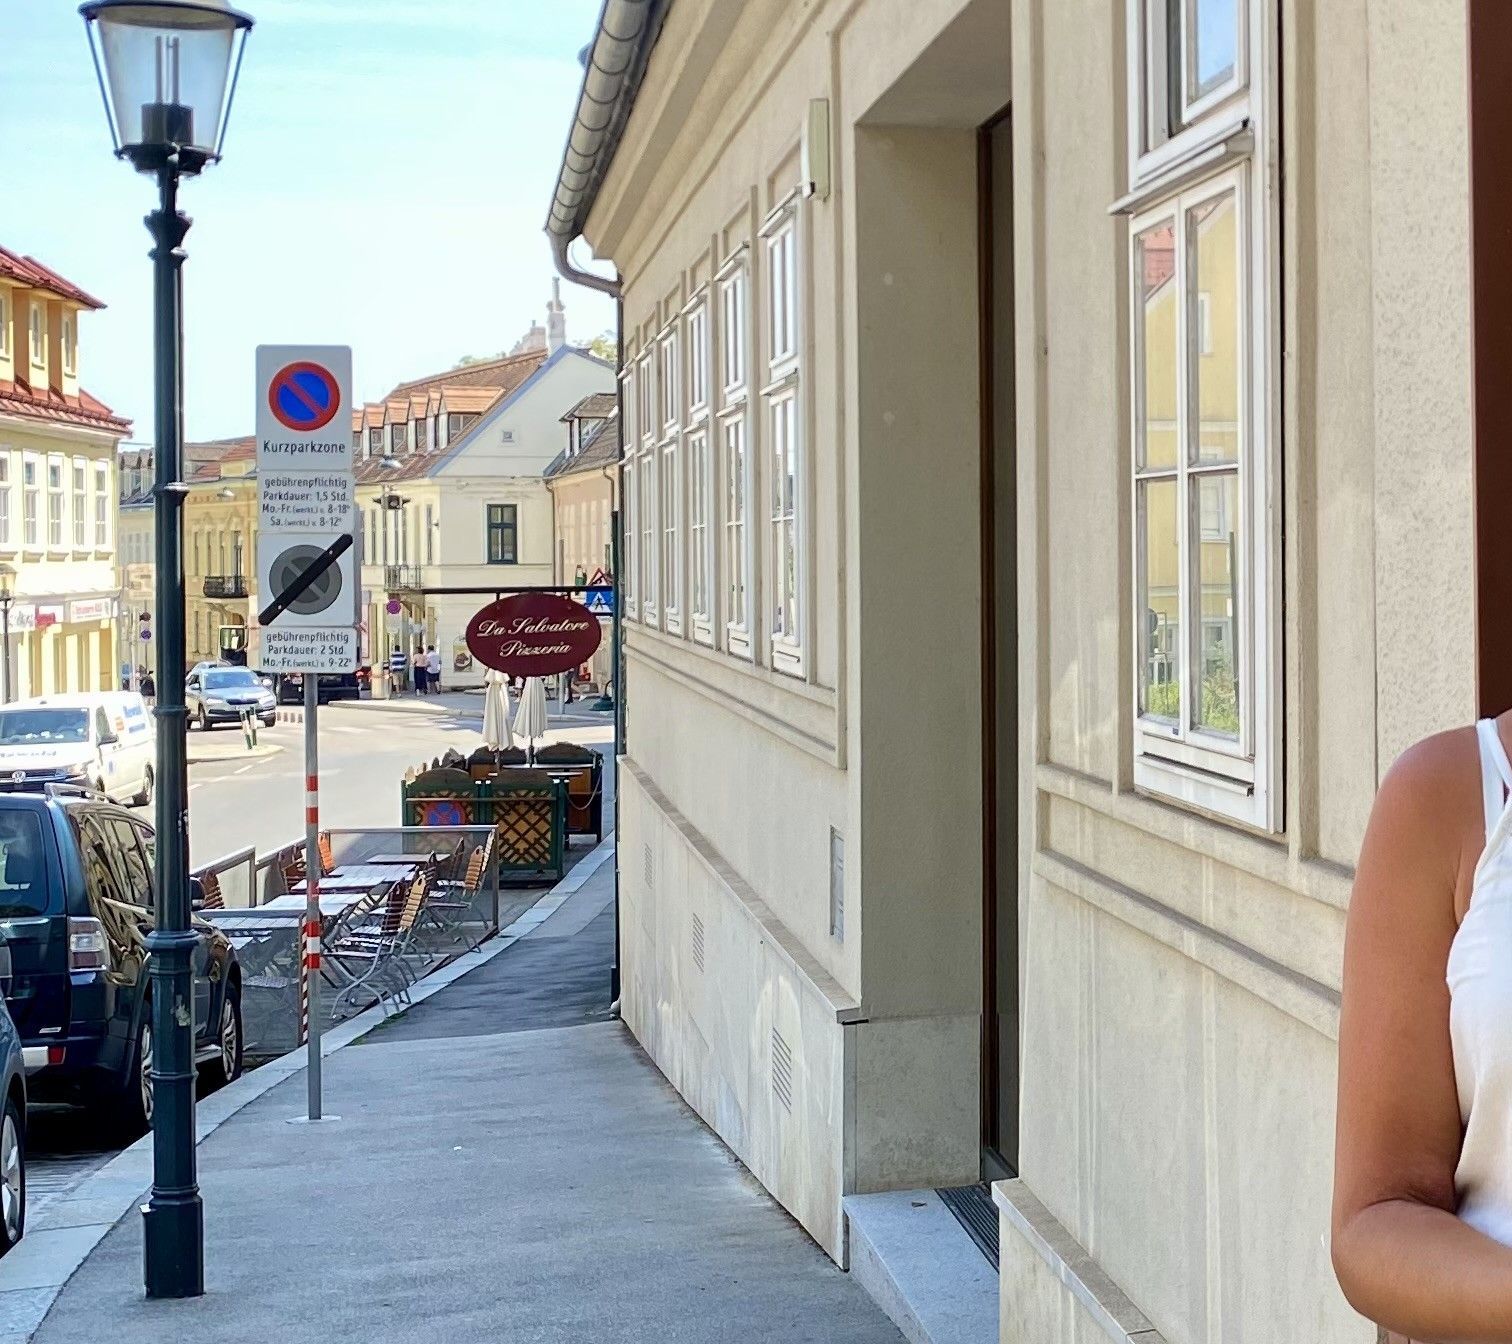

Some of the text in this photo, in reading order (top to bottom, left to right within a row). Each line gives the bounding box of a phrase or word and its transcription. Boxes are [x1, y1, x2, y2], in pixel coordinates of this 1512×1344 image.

[263, 440, 345, 456] Kurzparkzone
[265, 477, 347, 489] gebührenpflichtig
[263, 491, 312, 501] Parkdauer:
[316, 491, 328, 502] 1,5
[476, 619, 507, 637] Da
[508, 617, 590, 635] Salvatore
[266, 632, 349, 643] gebührenpflichtig
[268, 645, 317, 655] Parkdauer:
[320, 645, 326, 655] 2
[499, 640, 572, 658] Pizzeria
